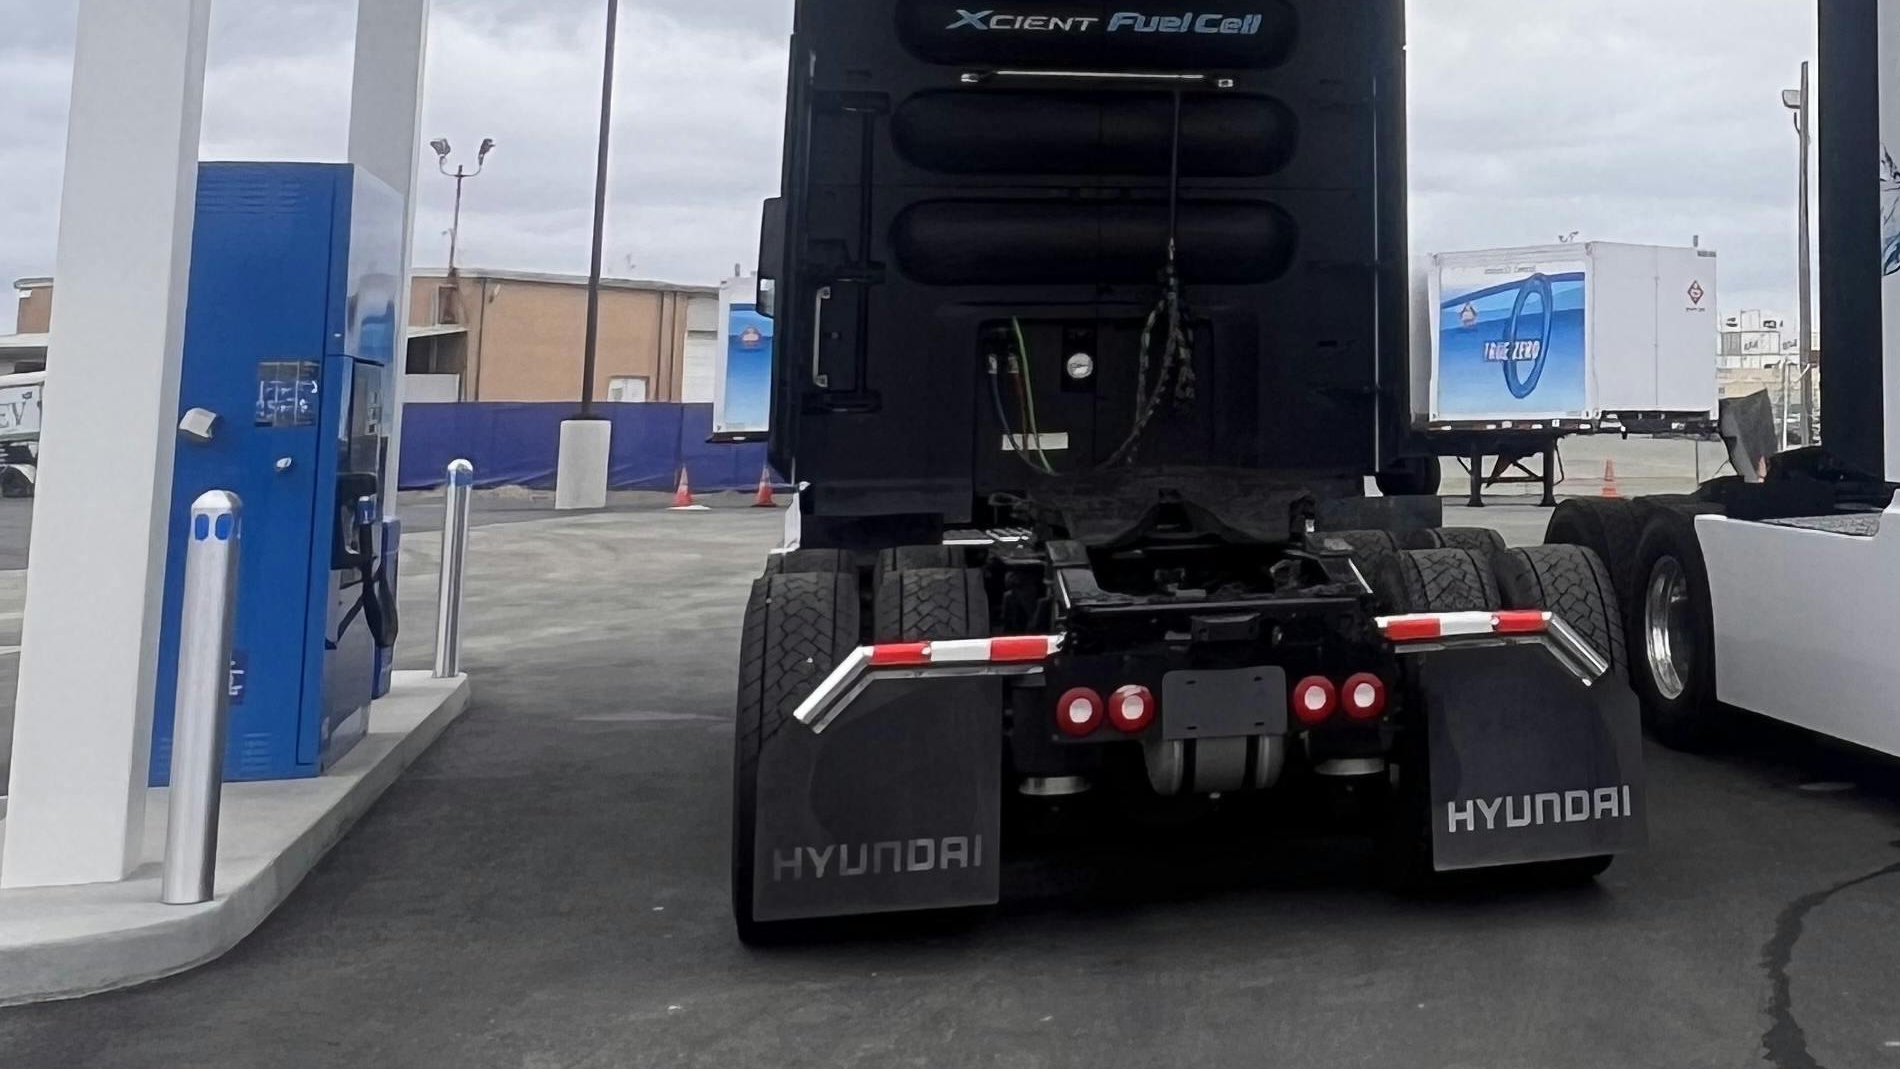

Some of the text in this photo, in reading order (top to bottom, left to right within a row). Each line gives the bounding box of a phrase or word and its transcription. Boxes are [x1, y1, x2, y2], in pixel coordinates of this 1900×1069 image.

[1107, 11, 1194, 32] Fuel
[1195, 13, 1263, 35] Cell
[1448, 785, 1631, 833] HYUNDAI
[773, 834, 982, 882] HYUNDAI
